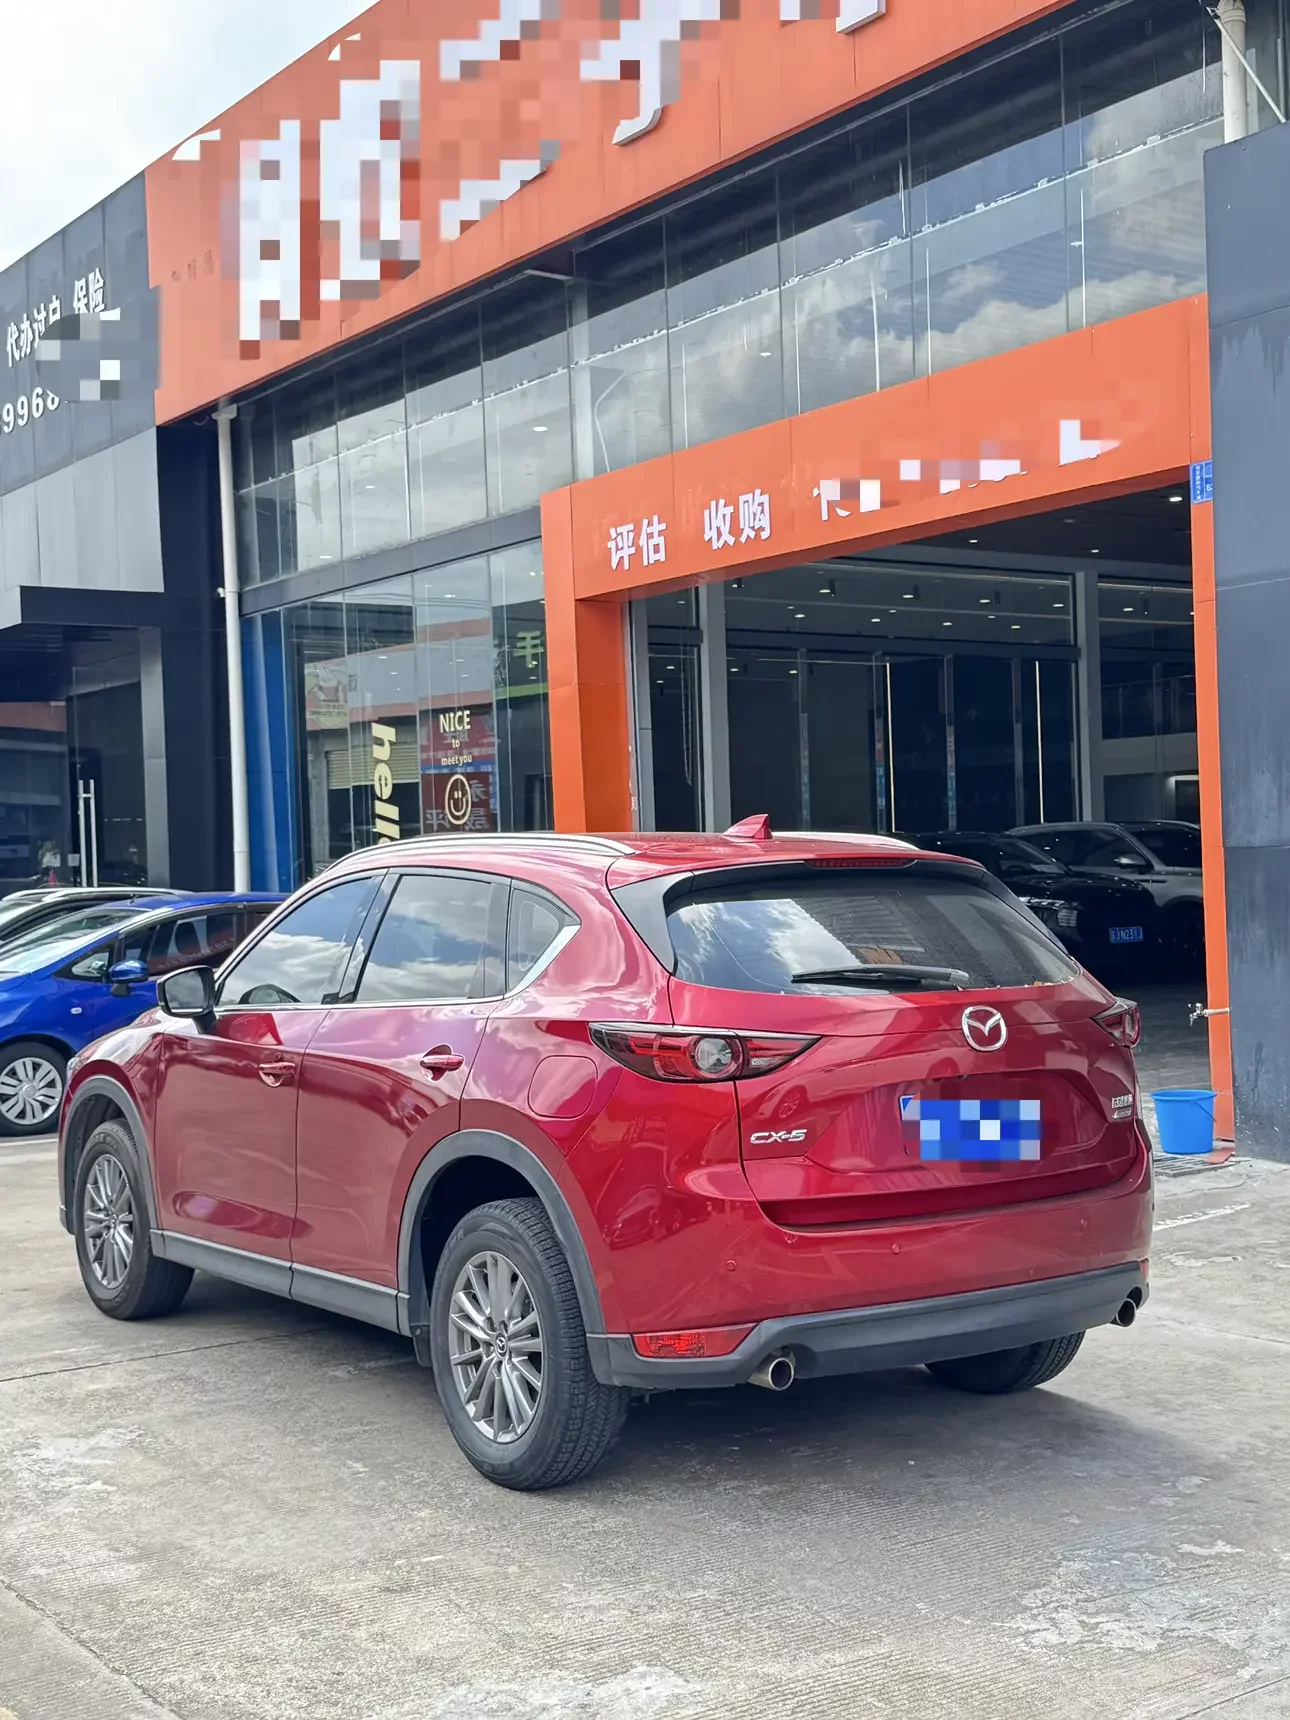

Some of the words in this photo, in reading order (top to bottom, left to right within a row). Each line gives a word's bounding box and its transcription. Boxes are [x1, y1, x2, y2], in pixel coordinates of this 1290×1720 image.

[73, 267, 105, 315] 保险
[607, 514, 668, 571] 评估
[703, 488, 772, 551] 收购
[439, 710, 471, 734] NICE
[452, 738, 461, 748] to
[441, 755, 459, 766] meet
[459, 754, 473, 766] you
[371, 722, 400, 845] hell
[750, 1129, 808, 1145] CX-5
